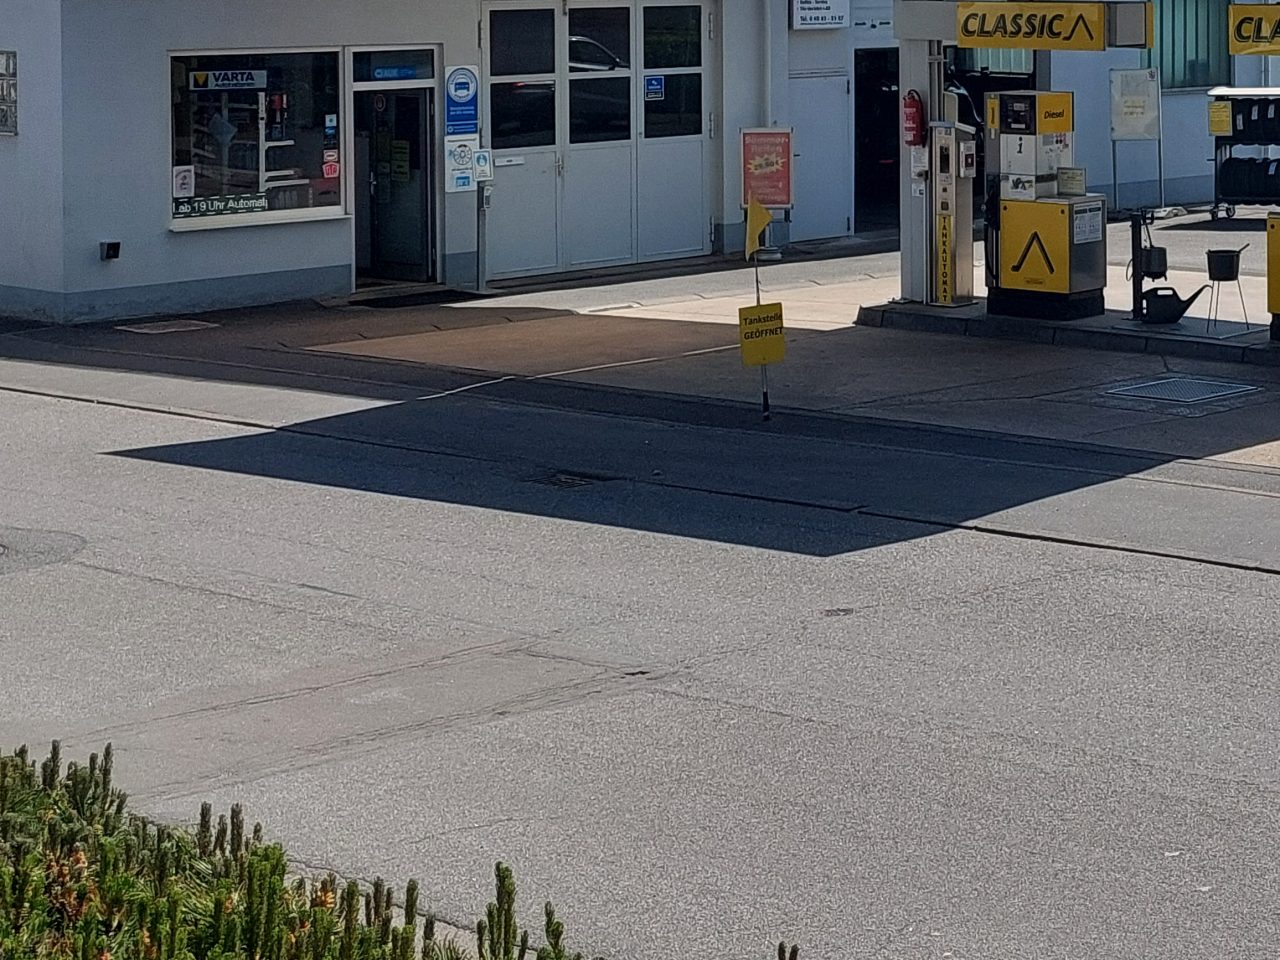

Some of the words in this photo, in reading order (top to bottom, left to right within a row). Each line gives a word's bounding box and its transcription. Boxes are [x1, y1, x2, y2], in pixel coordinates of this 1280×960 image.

[961, 13, 1065, 39] CLASSIC
[212, 72, 255, 82] VARTA
[1044, 110, 1065, 120] Diesel
[194, 202, 206, 211] 19
[208, 200, 225, 210] Uhr
[743, 313, 782, 326] Tankstelle
[744, 326, 784, 340] GEÖFFNET
